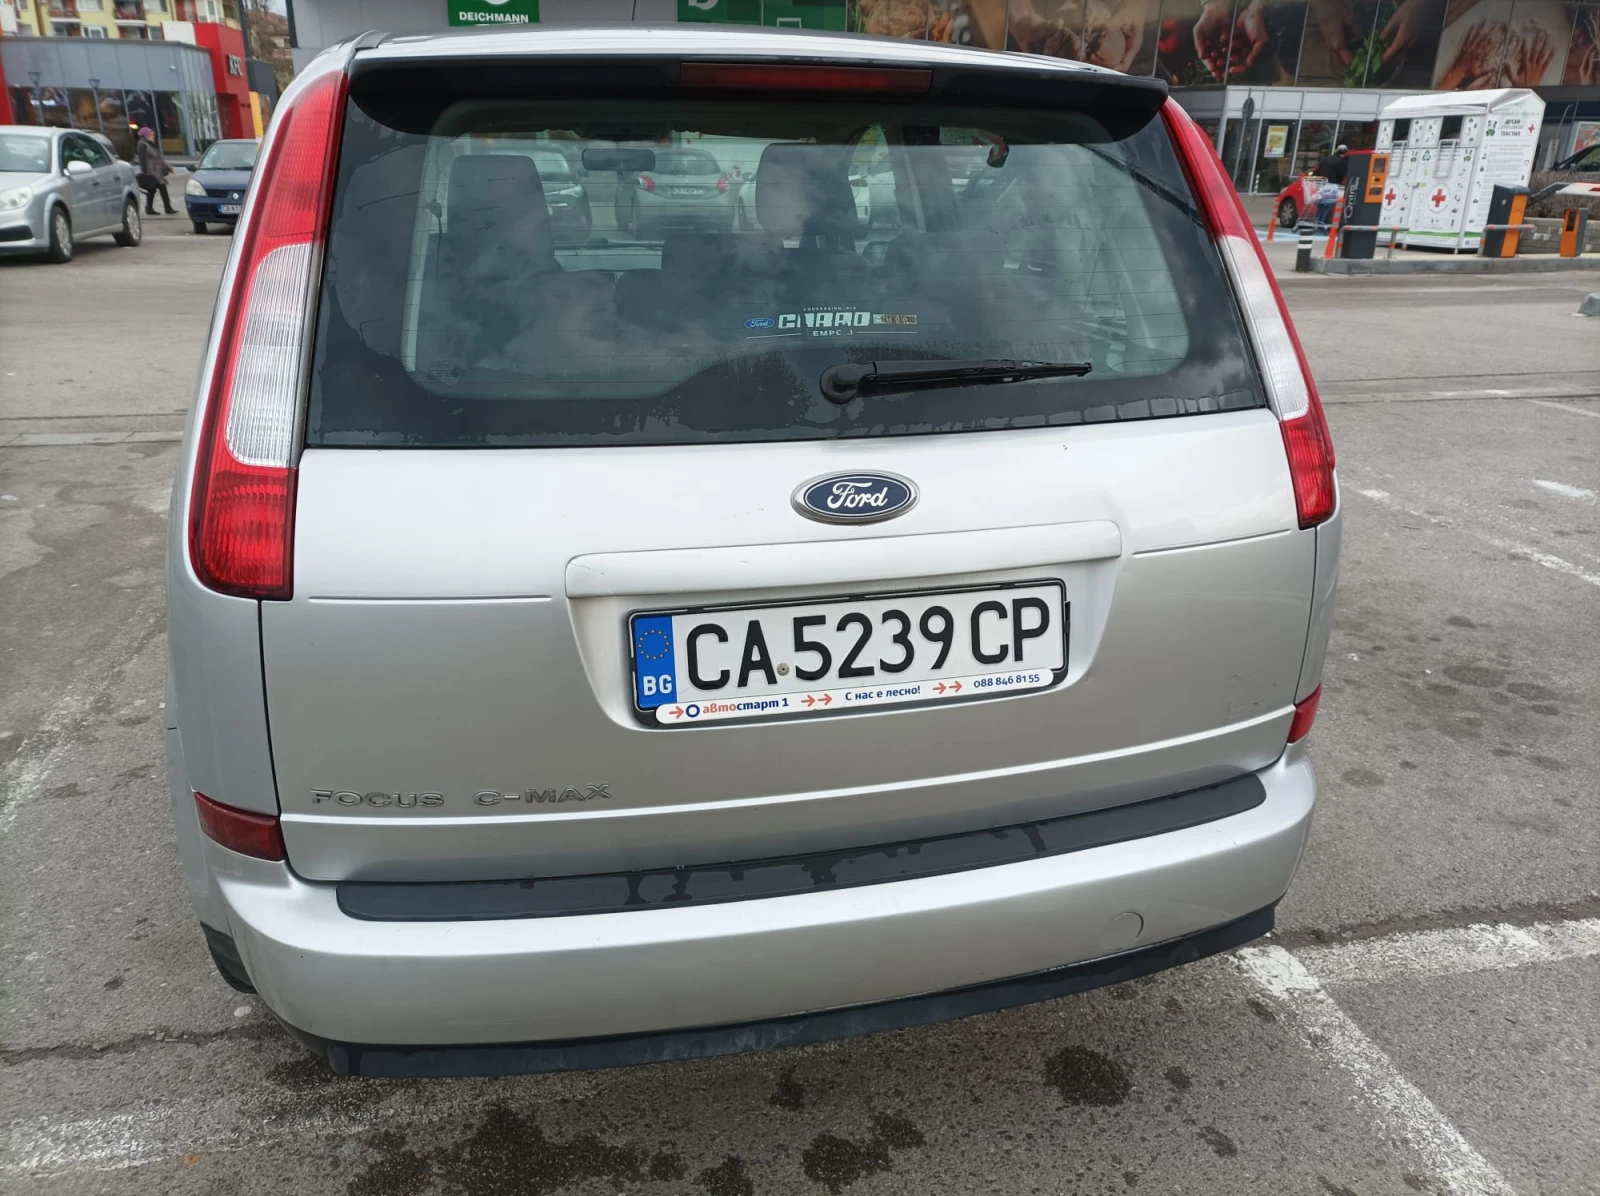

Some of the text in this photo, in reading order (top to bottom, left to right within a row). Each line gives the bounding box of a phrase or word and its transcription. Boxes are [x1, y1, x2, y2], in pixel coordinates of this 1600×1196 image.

[459, 11, 529, 23] DEICHMANN
[827, 481, 888, 509] Ford
[793, 605, 954, 681] 5239
[642, 674, 673, 696] BG
[845, 685, 921, 701] С нас е лесно!
[973, 678, 994, 689] 088
[782, 698, 789, 707] 1
[310, 784, 612, 808] FOCUS C-MAX
